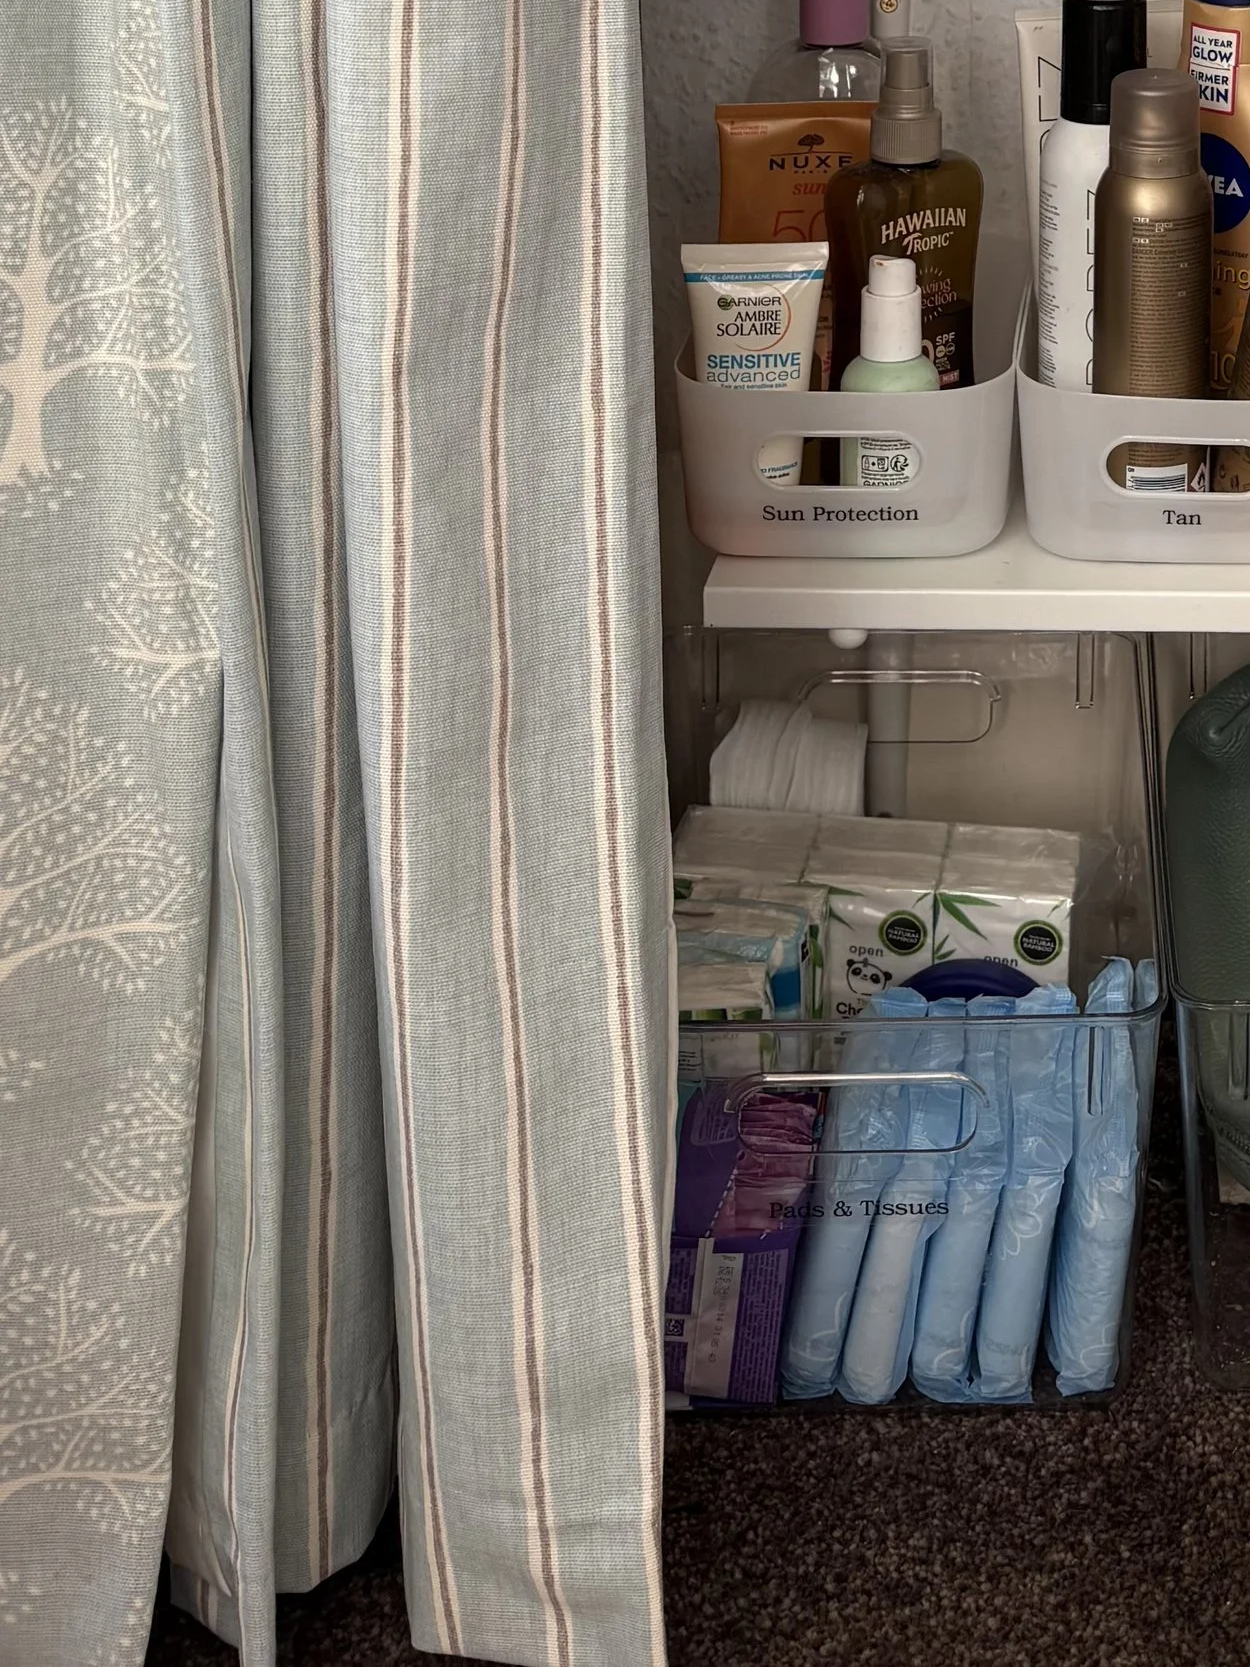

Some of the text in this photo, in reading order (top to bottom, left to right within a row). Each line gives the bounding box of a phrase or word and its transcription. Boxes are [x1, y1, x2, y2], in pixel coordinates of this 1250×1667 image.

[1193, 34, 1233, 48] ALL YEAR
[1192, 46, 1233, 63] GLOW
[1190, 70, 1229, 85] FIRMER
[1199, 84, 1229, 104] KIN
[880, 207, 967, 245] HAWAIIAN
[717, 296, 781, 308] GARNIER
[734, 310, 781, 322] AMBRE
[716, 322, 781, 337] SOLAIRE
[935, 332, 955, 346] SPF
[707, 352, 801, 369] SENSITIVE
[706, 367, 801, 383] advanced
[762, 505, 919, 521] Sun Protection
[1162, 509, 1202, 525] Tan
[888, 929, 919, 939] NATURAL
[889, 933, 918, 944] BAMBOO
[1022, 937, 1055, 948] NATURAL
[1023, 942, 1053, 953] BAMBOO
[849, 944, 884, 958] open
[769, 1199, 949, 1219] Pads & Tissues
